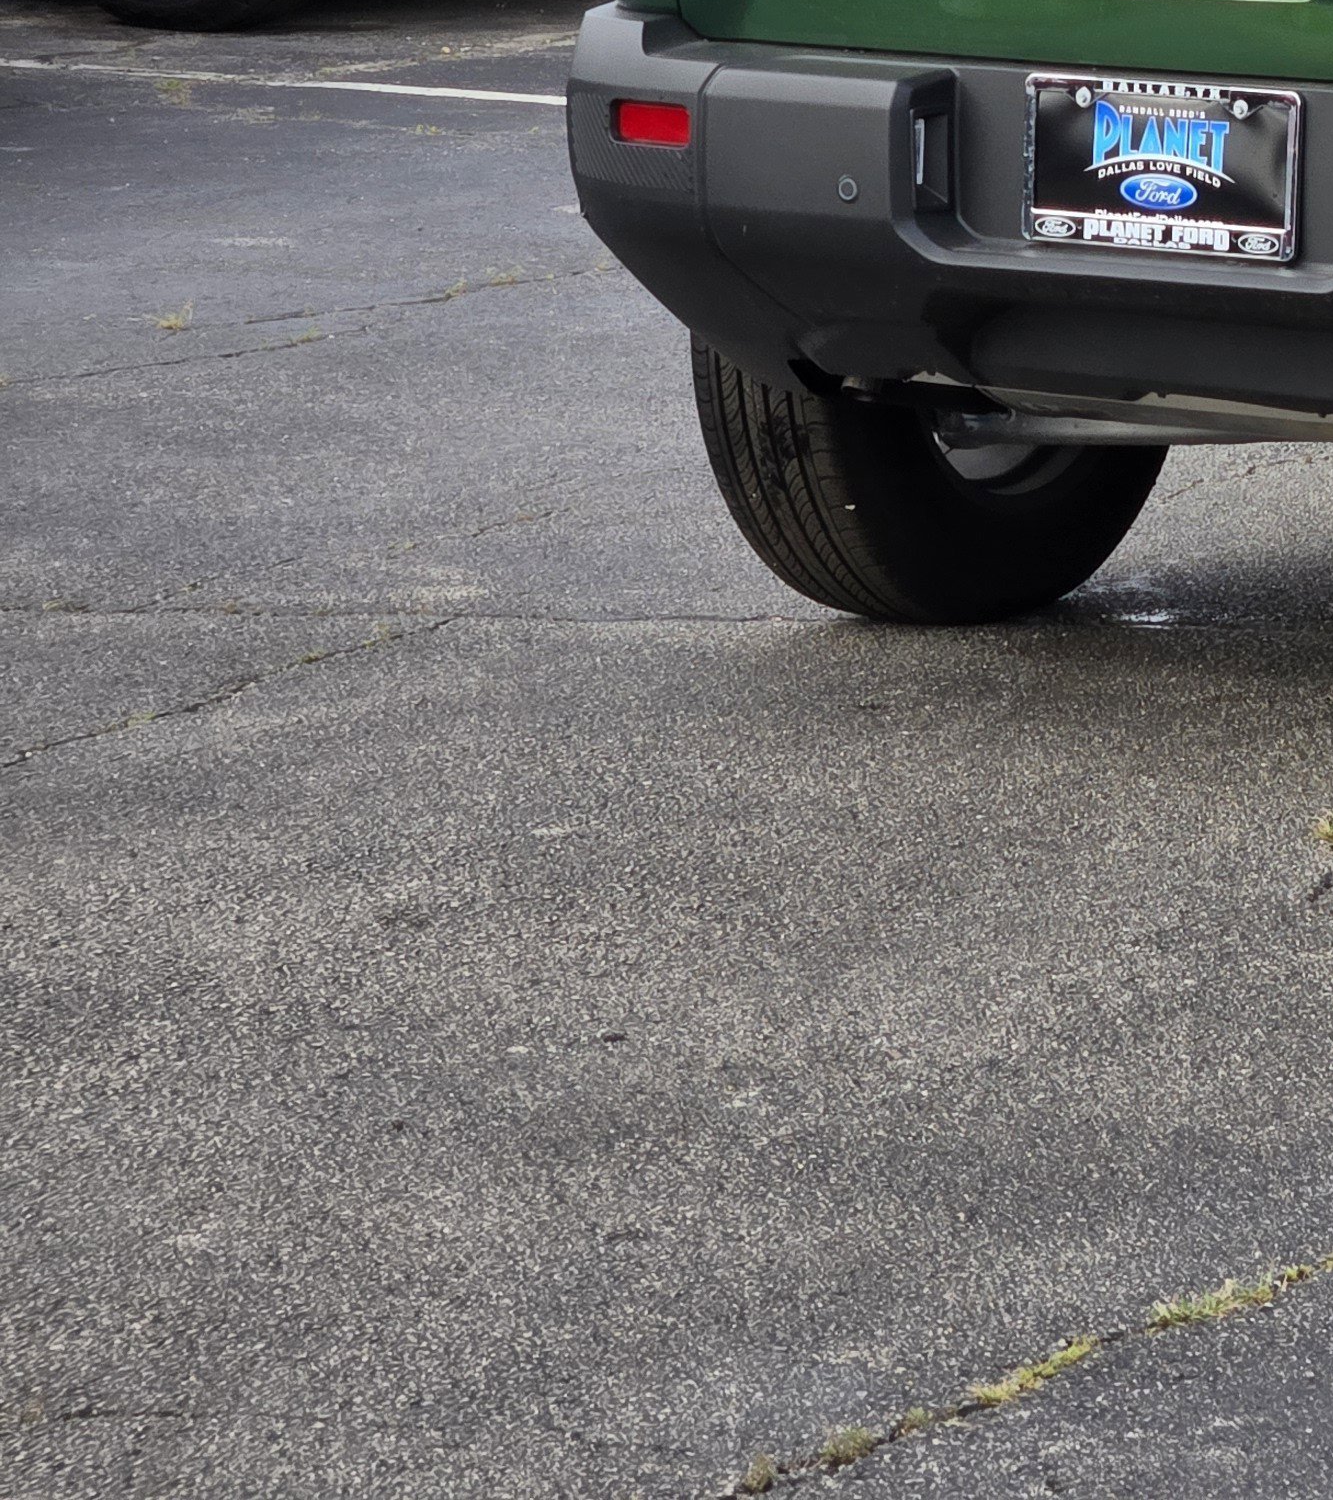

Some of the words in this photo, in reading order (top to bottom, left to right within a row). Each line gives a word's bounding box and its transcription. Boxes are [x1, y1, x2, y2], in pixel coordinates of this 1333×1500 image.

[1093, 100, 1230, 173] PLANET
[1097, 161, 1145, 179] DALLAS
[1149, 161, 1182, 174] LOVE
[1185, 166, 1222, 188] FIELD
[1135, 179, 1182, 205] Ford
[1083, 217, 1166, 241] PLANET
[1171, 226, 1230, 251] FORD
